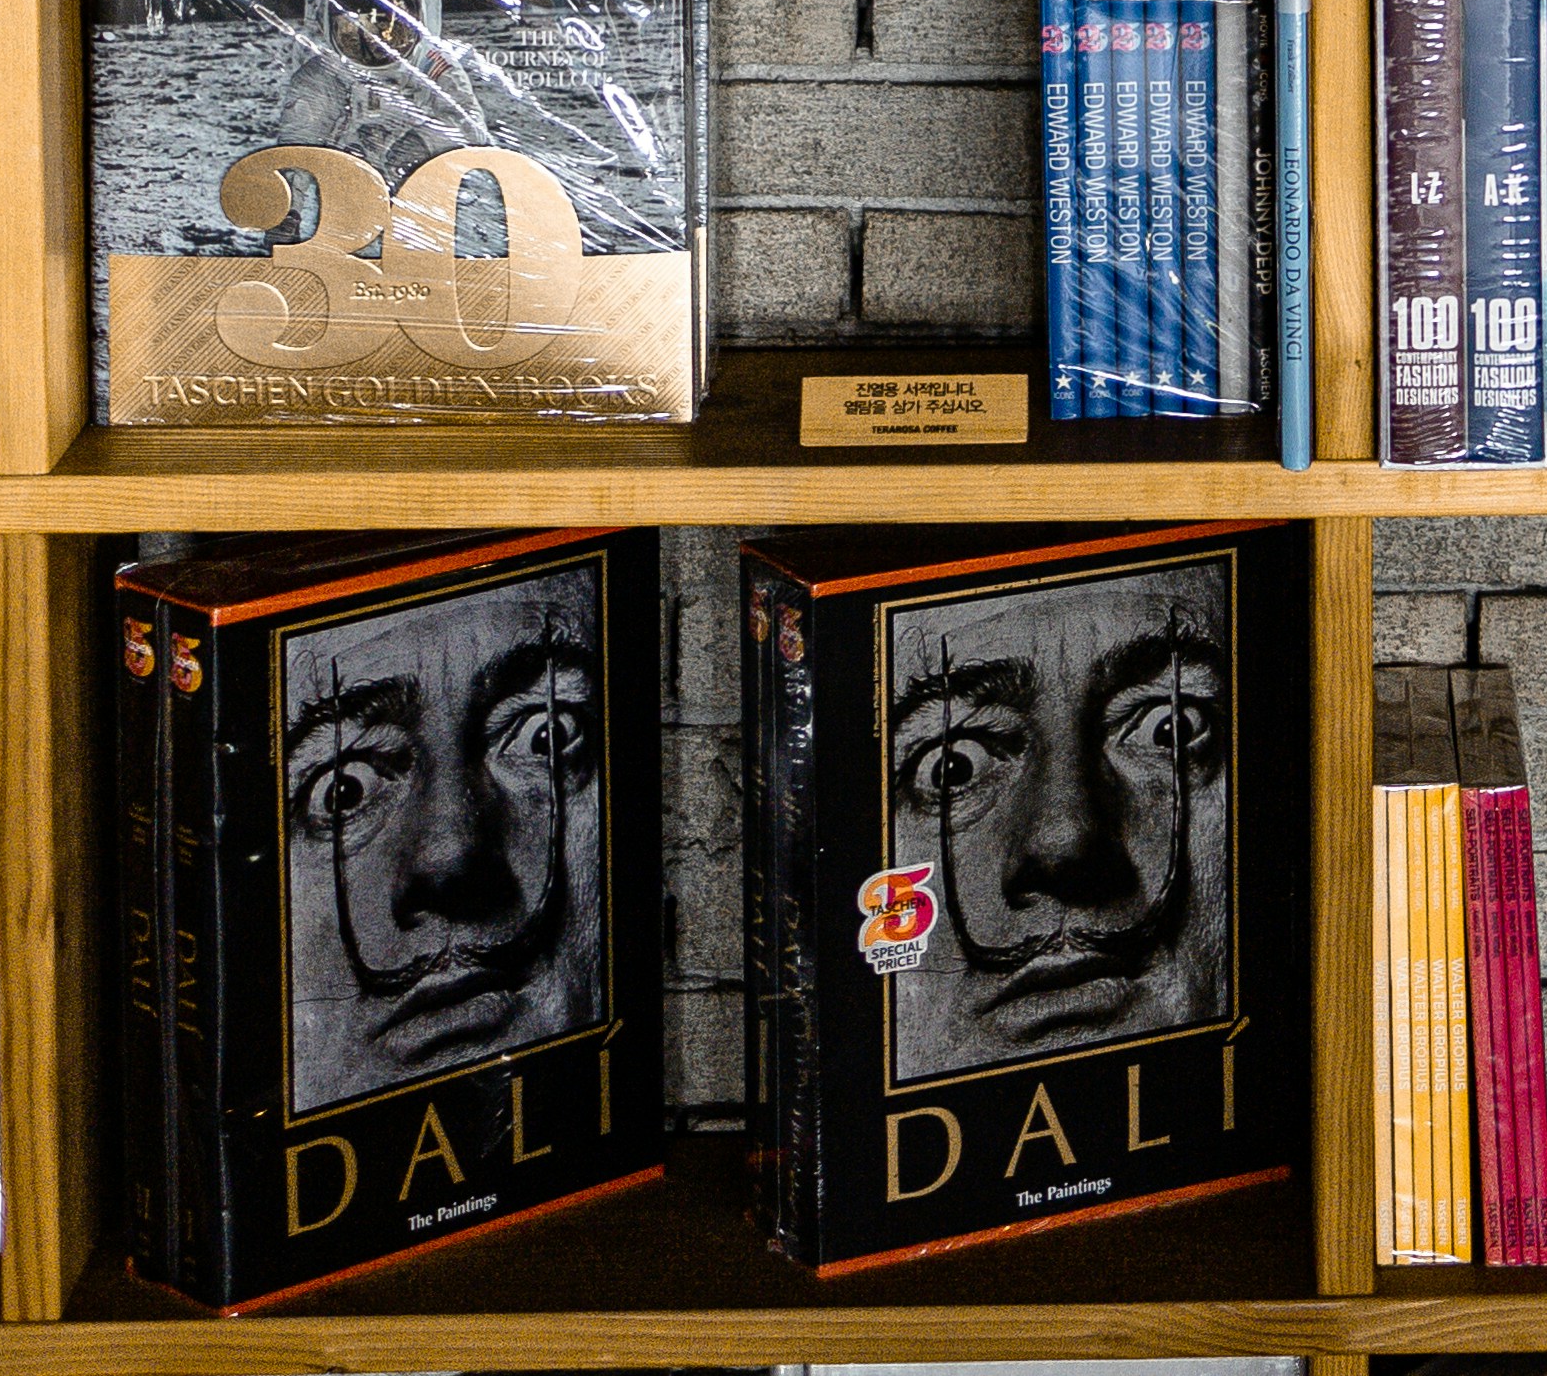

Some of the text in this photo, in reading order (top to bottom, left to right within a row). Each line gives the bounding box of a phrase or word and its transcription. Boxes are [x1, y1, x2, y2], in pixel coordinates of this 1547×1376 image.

[1047, 83, 1072, 264] EDWARD WESTON
[1255, 147, 1273, 296] JOHNNY DEPP
[215, 144, 584, 370] 30
[1283, 147, 1302, 362] LEONARDO DA VINCI
[143, 374, 314, 409] TASCHEN
[322, 374, 498, 409] GOLDEN
[855, 381, 977, 398] 진열용 서적입니다.
[922, 424, 959, 434] COFFEE
[286, 1018, 624, 1237] DALÍ
[407, 1190, 498, 1231] The Paintings
